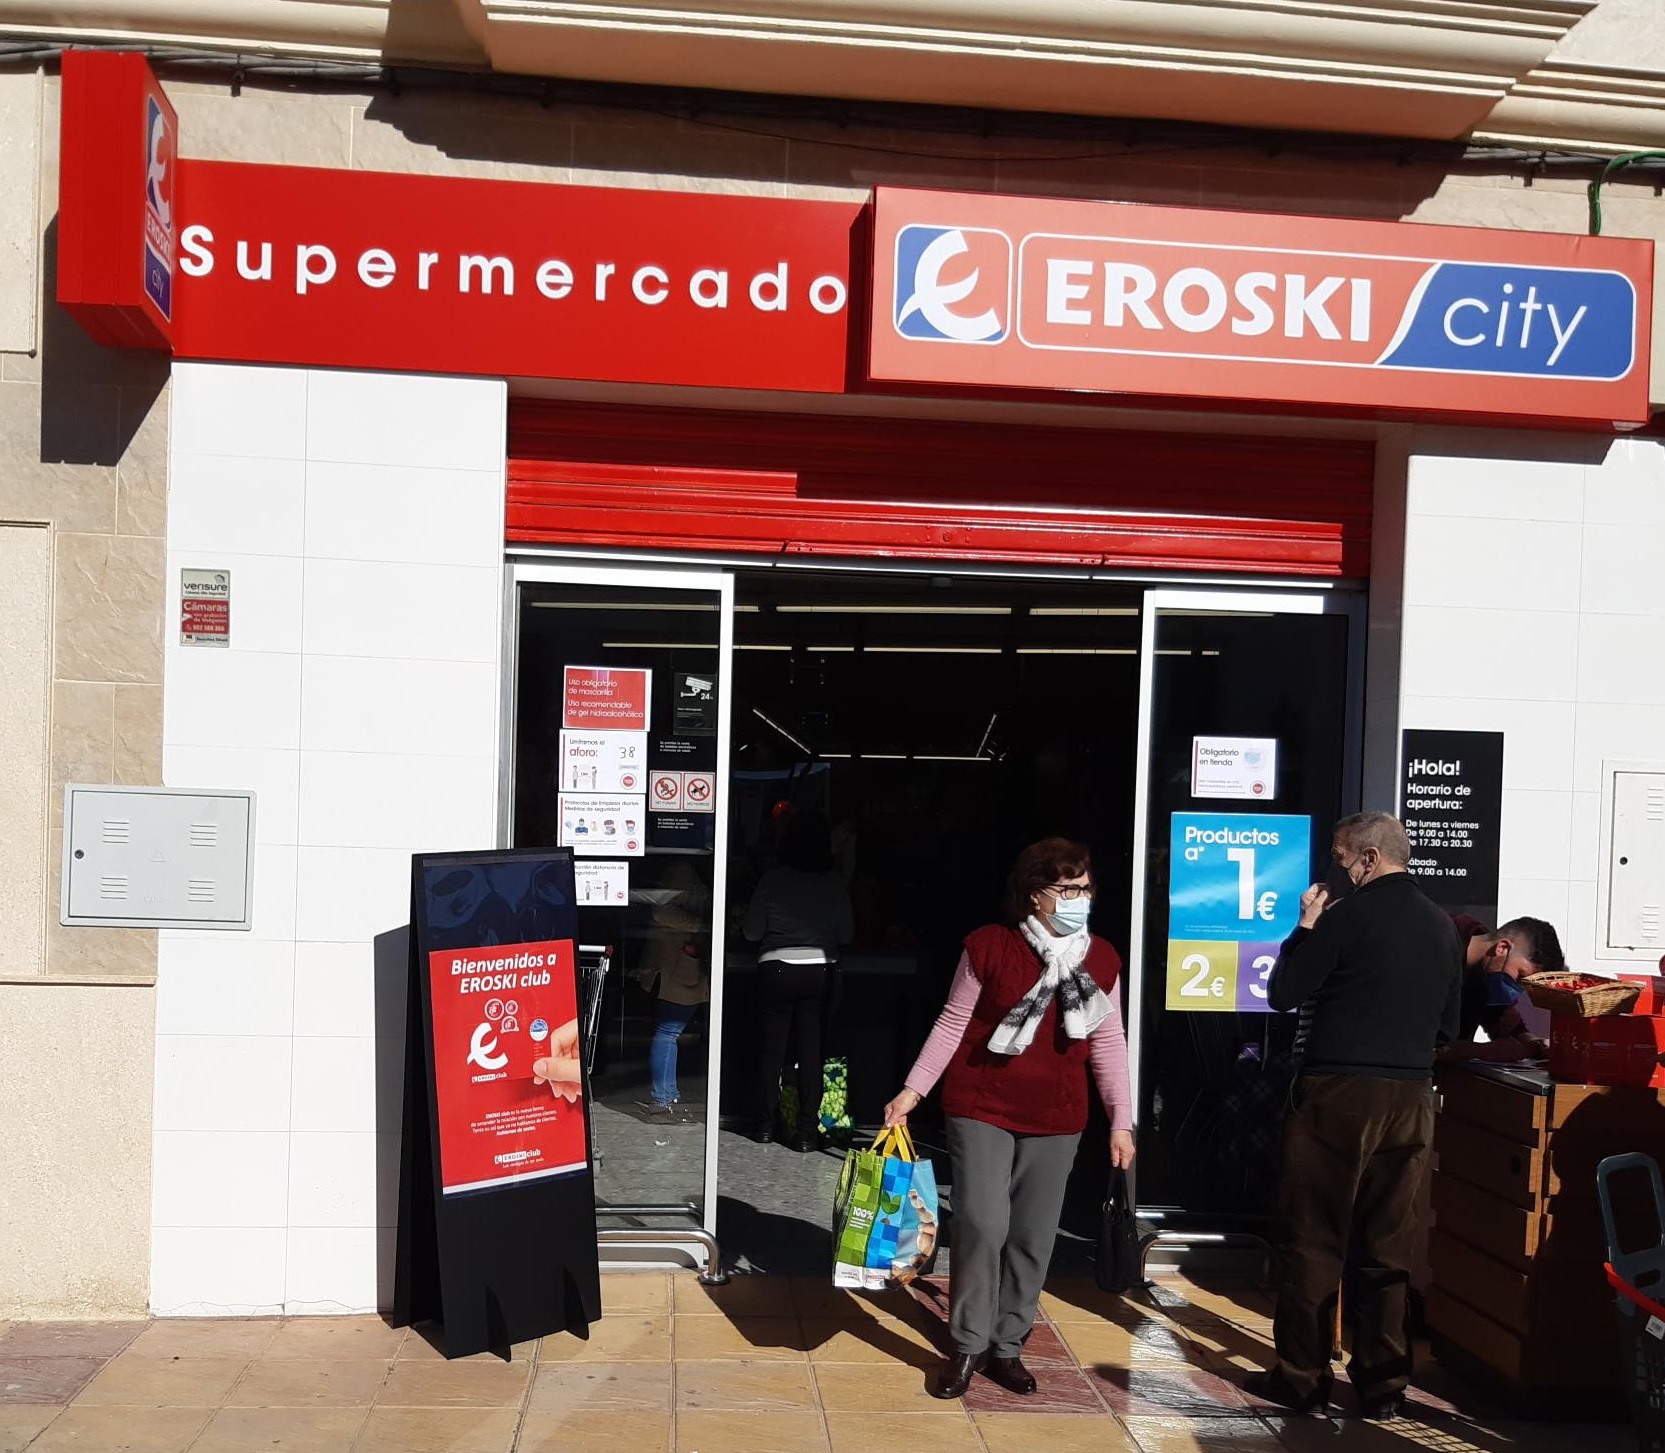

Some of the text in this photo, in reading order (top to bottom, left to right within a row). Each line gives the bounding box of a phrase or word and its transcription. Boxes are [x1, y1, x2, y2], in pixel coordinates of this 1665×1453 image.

[179, 223, 848, 316] Supermercado
[1045, 257, 1588, 367] EROSKI city
[183, 582, 228, 592] verisure
[183, 601, 228, 612] Cámaras
[568, 678, 618, 688] Uso obligatorio
[578, 689, 613, 697] mascarilla
[567, 699, 633, 709] Uso recomendable
[567, 708, 577, 716] de
[578, 709, 589, 718] gel
[569, 738, 599, 746] Limitamos
[569, 746, 599, 758] aforo:
[1199, 747, 1240, 757] Obligatorio
[1210, 758, 1233, 767] tienda
[1408, 758, 1460, 778] ¡Hola!
[1407, 782, 1472, 796] Horario de
[1406, 798, 1463, 811] apertura:
[1406, 819, 1479, 830] De lunes a viernes
[1184, 826, 1280, 846] Productos
[1418, 829, 1436, 838] 9.00
[1446, 829, 1468, 839] 14.00
[1419, 838, 1441, 847] 17.30
[1442, 840, 1449, 848] a
[1449, 839, 1473, 849] 20.30
[1408, 857, 1438, 867] ábado
[1417, 867, 1435, 876] 9.00
[1445, 868, 1467, 877] 14.00
[451, 952, 557, 976] Bienvenidos a
[460, 969, 551, 994] EROSKI club
[526, 1148, 541, 1157] club
[852, 1206, 874, 1221] 100%
